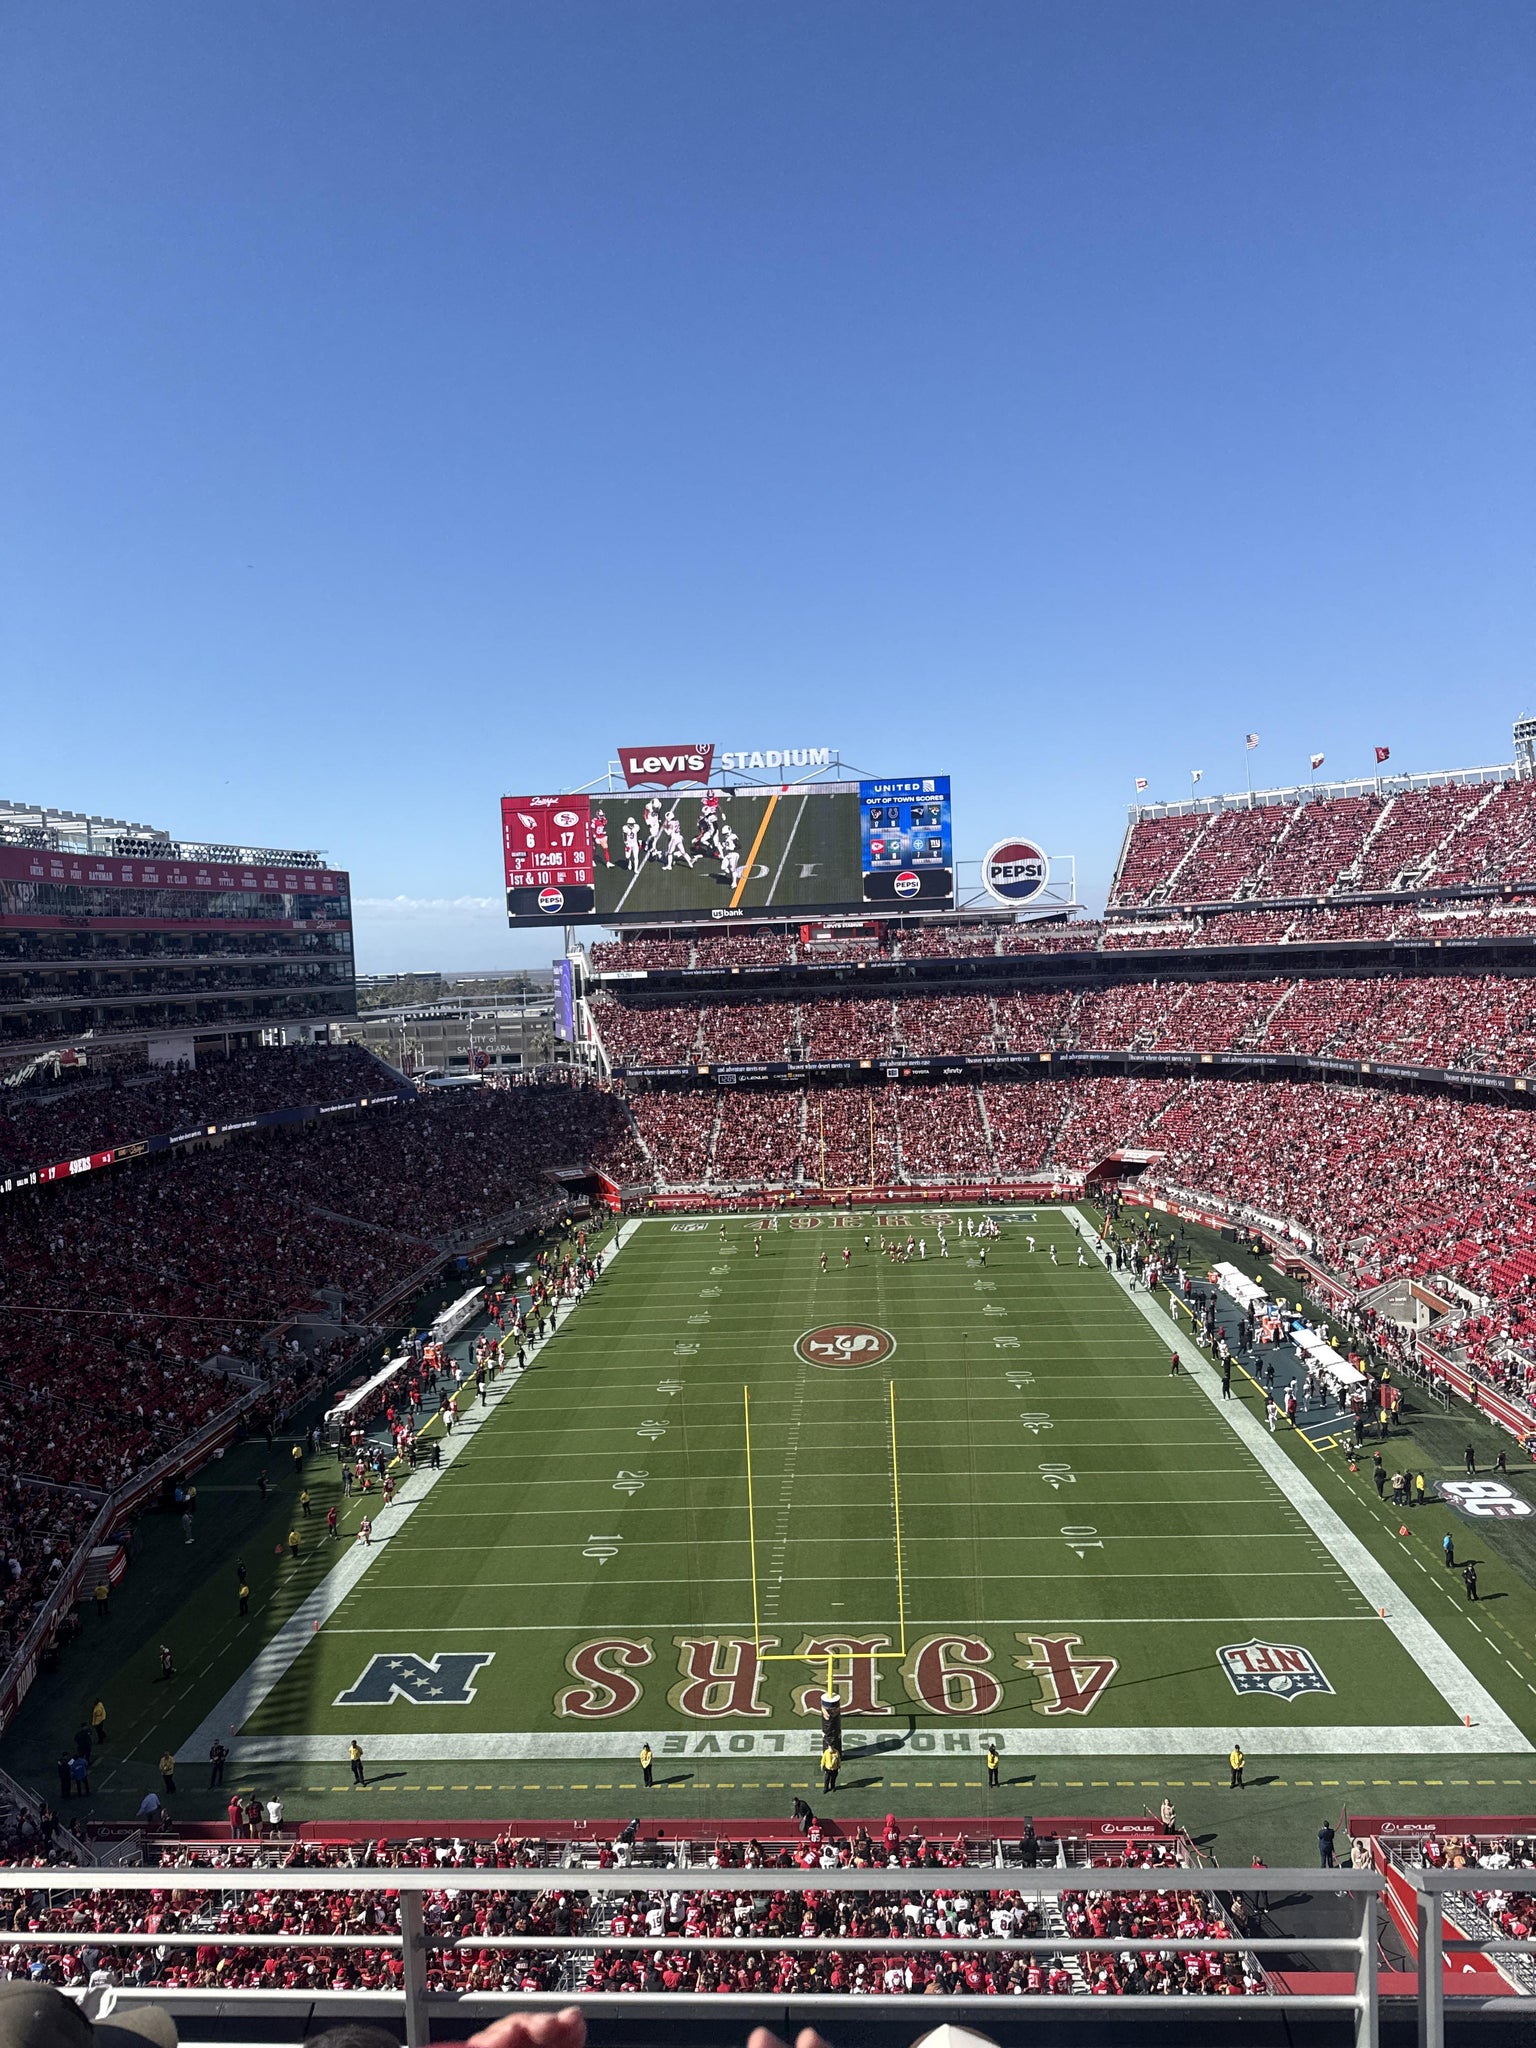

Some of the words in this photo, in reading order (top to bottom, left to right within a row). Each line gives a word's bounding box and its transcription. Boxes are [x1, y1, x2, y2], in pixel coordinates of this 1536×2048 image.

[721, 748, 830, 770] STADIUM
[874, 783, 920, 792] UNITED
[526, 833, 535, 848] 6
[560, 832, 574, 846] 17
[534, 852, 563, 866] 12:05
[573, 851, 585, 863] 39
[509, 873, 524, 885] 1ST
[525, 872, 534, 884] &
[538, 871, 549, 884] 10
[574, 870, 585, 881] 19
[991, 864, 1042, 878] PEPSI
[1472, 1076, 1485, 1084] desert
[48, 1166, 56, 1180] 17
[69, 1156, 91, 1175] 49ERS
[4, 1179, 12, 1192] 10
[743, 1212, 954, 1229] 49ERS
[656, 1378, 686, 1391] 40
[1005, 1371, 1036, 1384] 40
[636, 1419, 670, 1436] 30
[1020, 1412, 1054, 1429] 30
[612, 1470, 649, 1489] 20
[1038, 1463, 1077, 1483] 20
[1060, 1526, 1104, 1548] 10
[582, 1534, 623, 1556] 10
[1227, 1649, 1309, 1674] NFL
[552, 1633, 1120, 1720] 49ERS
[662, 1734, 786, 1753] LOVE
[1431, 1848, 1440, 1857] 19
[652, 1916, 661, 1928] 19
